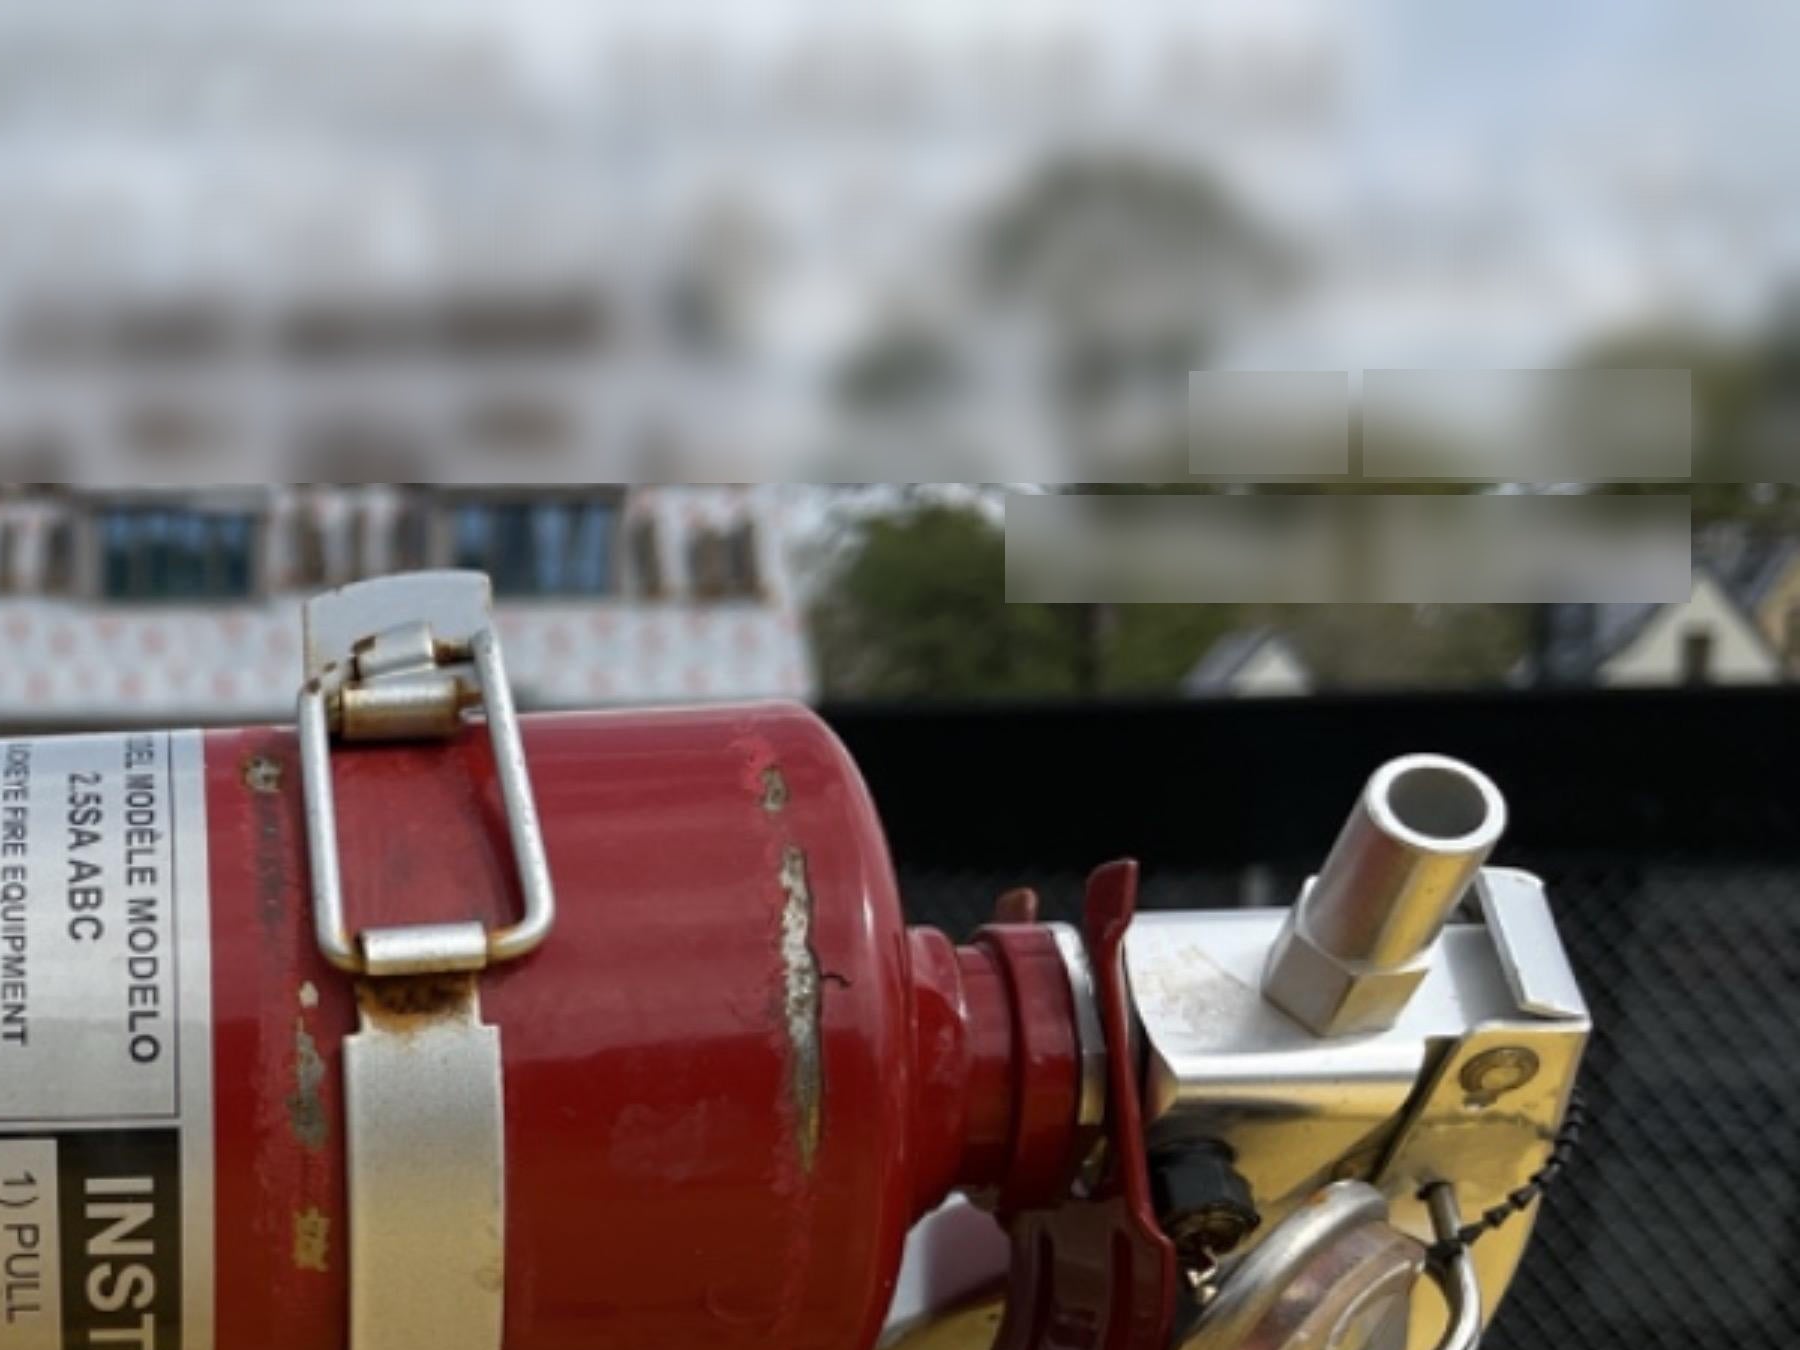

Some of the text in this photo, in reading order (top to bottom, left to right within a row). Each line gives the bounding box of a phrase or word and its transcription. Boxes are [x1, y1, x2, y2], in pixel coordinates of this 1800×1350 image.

[1, 806, 28, 856] FIRE
[68, 772, 104, 942] 2.5SA ABC
[125, 774, 162, 886] MODÈLE
[0, 865, 28, 1046] EQUIPMENT
[127, 898, 160, 1064] MODELO
[4, 1221, 42, 1326] PULL
